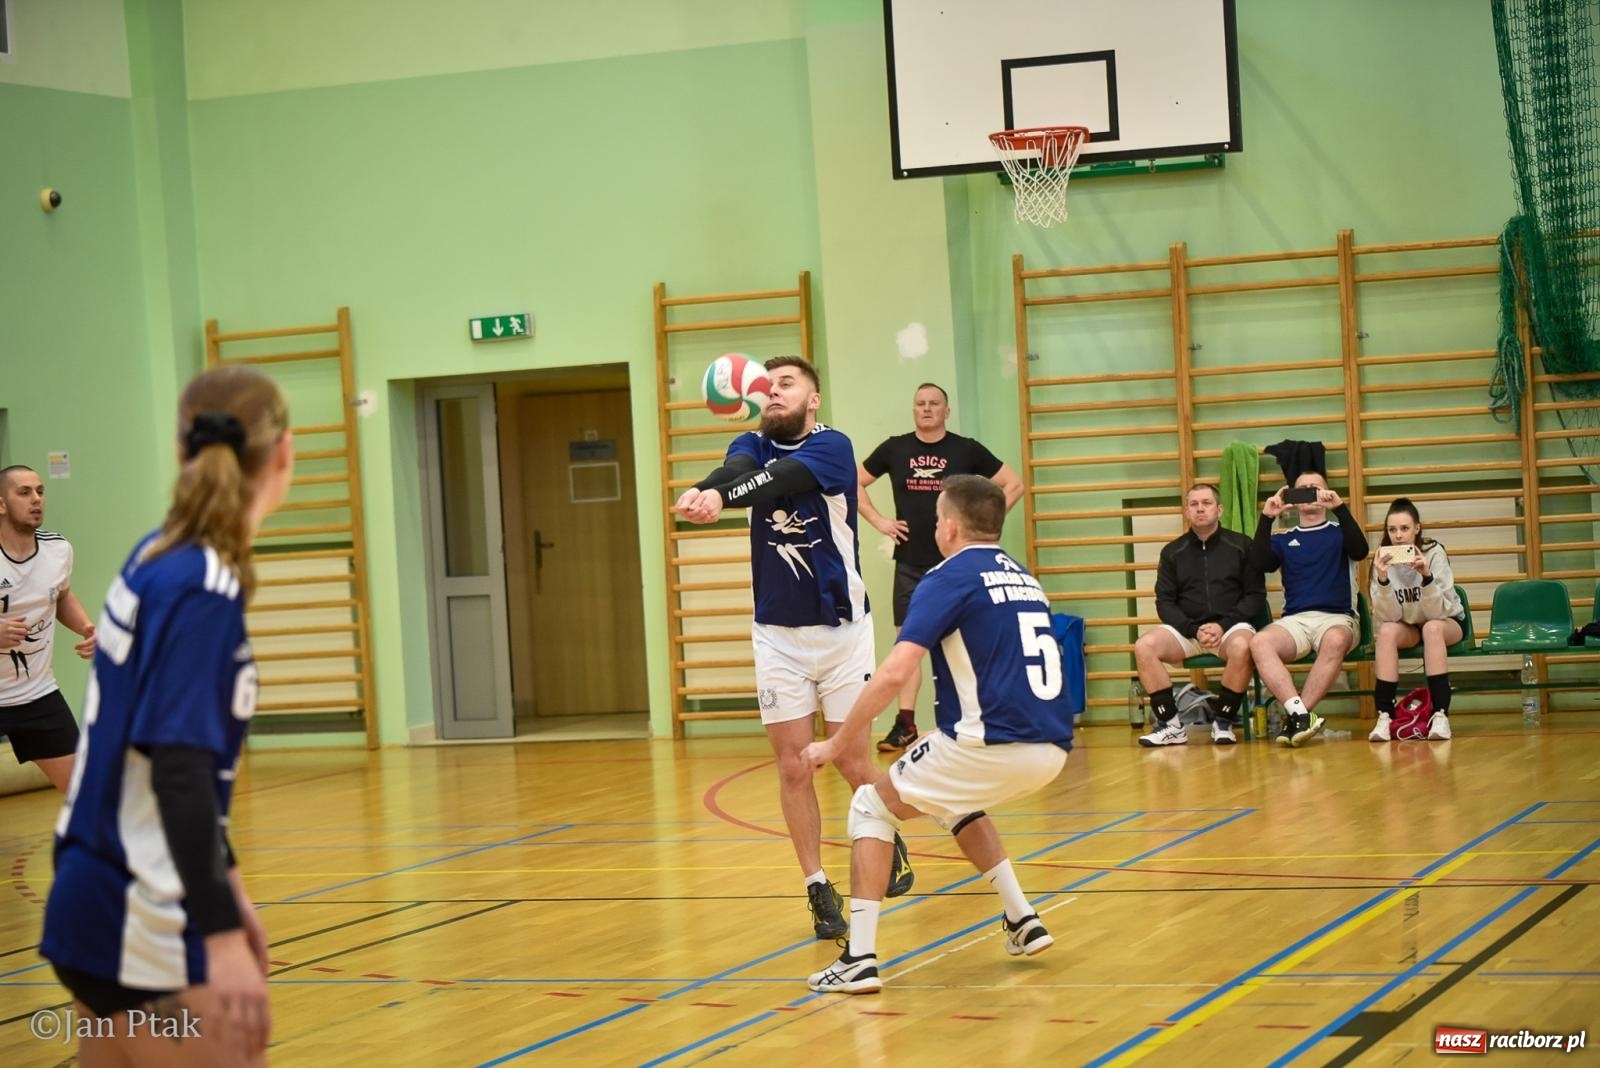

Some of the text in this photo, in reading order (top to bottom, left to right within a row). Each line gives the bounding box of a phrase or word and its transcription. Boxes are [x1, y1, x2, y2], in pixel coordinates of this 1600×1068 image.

[909, 455, 948, 469] ASICS
[732, 482, 749, 499] CAN
[1017, 611, 1063, 701] 5
[232, 664, 258, 720] 6
[910, 740, 930, 764] 5
